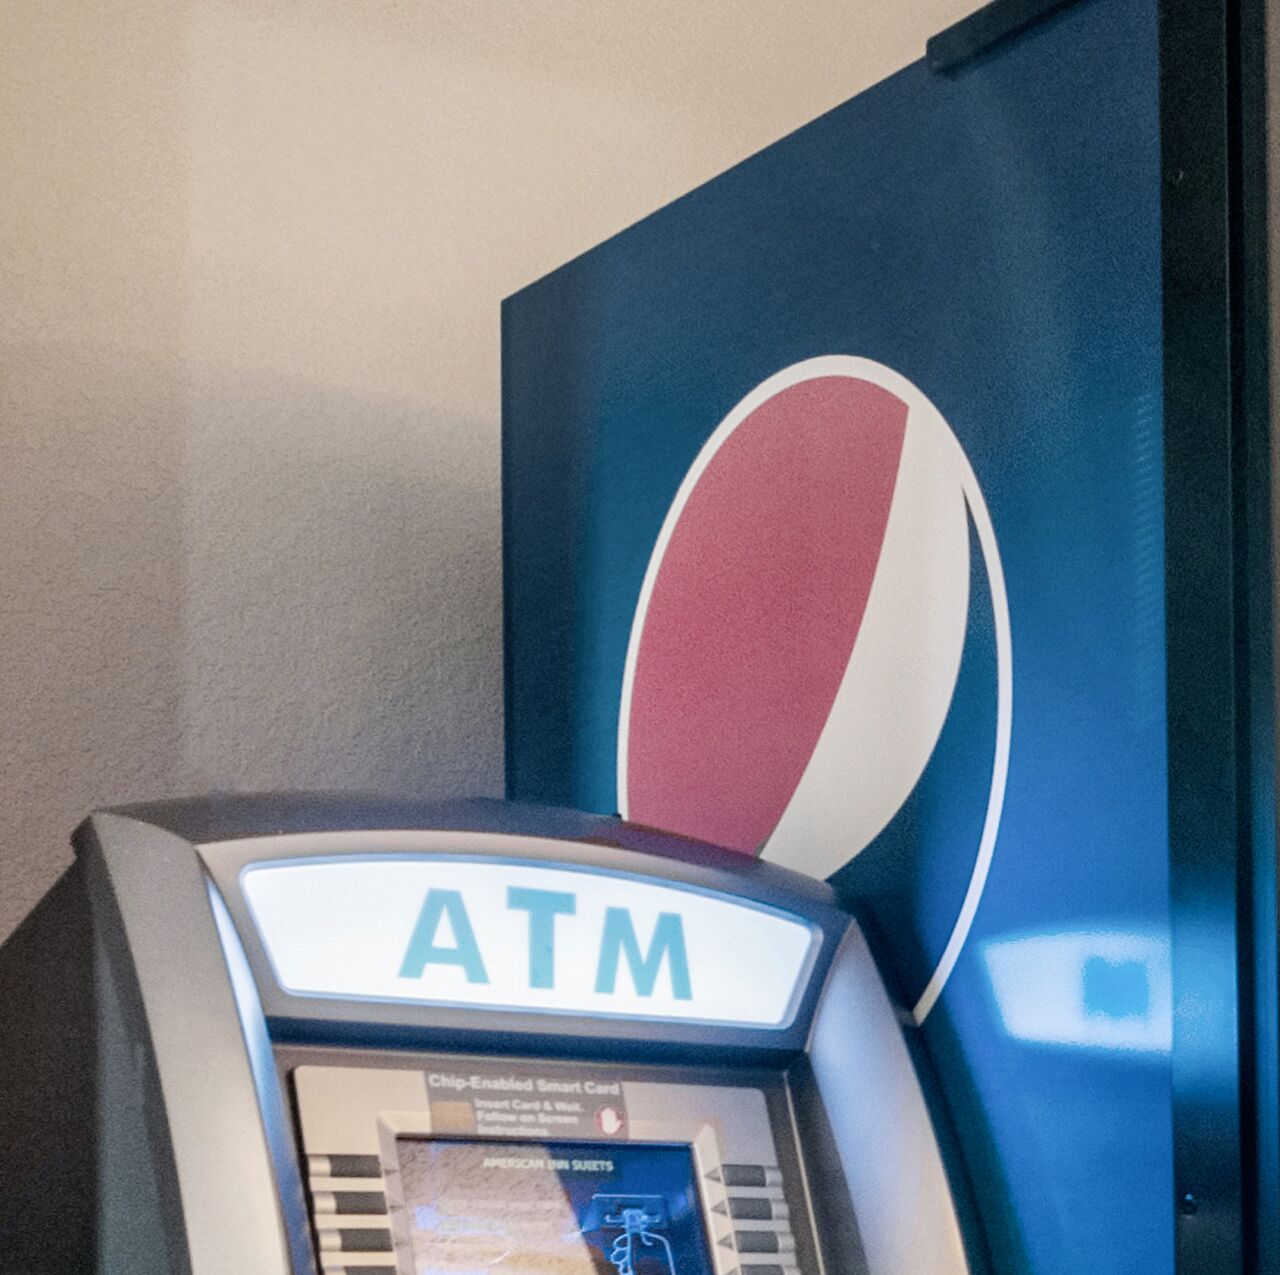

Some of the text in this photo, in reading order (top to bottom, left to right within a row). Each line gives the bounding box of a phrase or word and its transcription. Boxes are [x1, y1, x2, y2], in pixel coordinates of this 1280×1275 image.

[398, 885, 694, 1001] ATM
[428, 1074, 620, 1095] Chip-Enabled Smart Card
[482, 1156, 546, 1169] AMERICAN
